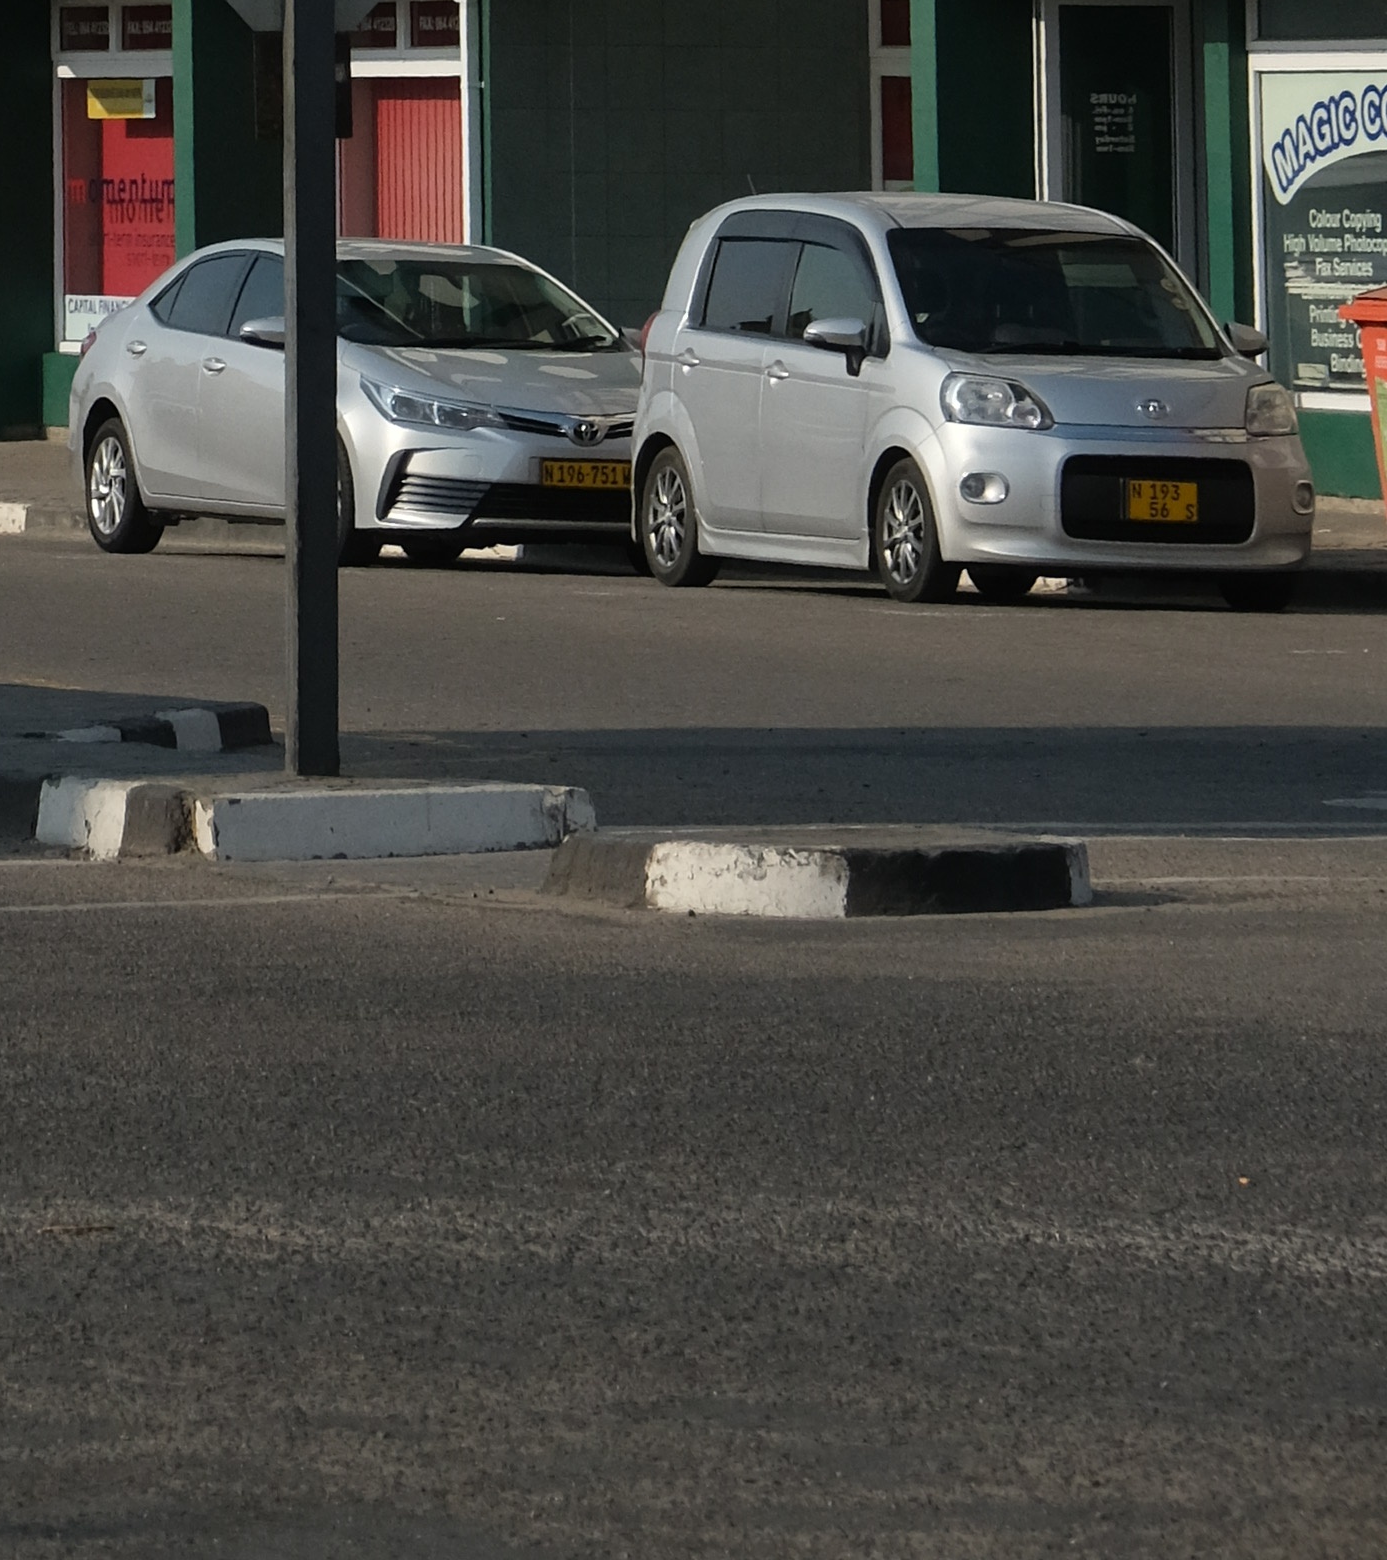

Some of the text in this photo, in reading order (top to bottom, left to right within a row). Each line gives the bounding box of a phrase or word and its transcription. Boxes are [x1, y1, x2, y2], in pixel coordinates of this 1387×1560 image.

[1272, 90, 1358, 194] MAGIC
[1309, 208, 1382, 233] Colour Copying
[1283, 233, 1306, 257] High
[1307, 233, 1343, 253] Volume
[1315, 257, 1374, 277] Fax Services
[68, 298, 97, 315] CAPITAL
[1311, 328, 1354, 348] Business
[544, 464, 554, 482] N
[557, 465, 618, 485] 196-751
[1132, 483, 1180, 501] N 193
[1149, 501, 1195, 520] 56 S
